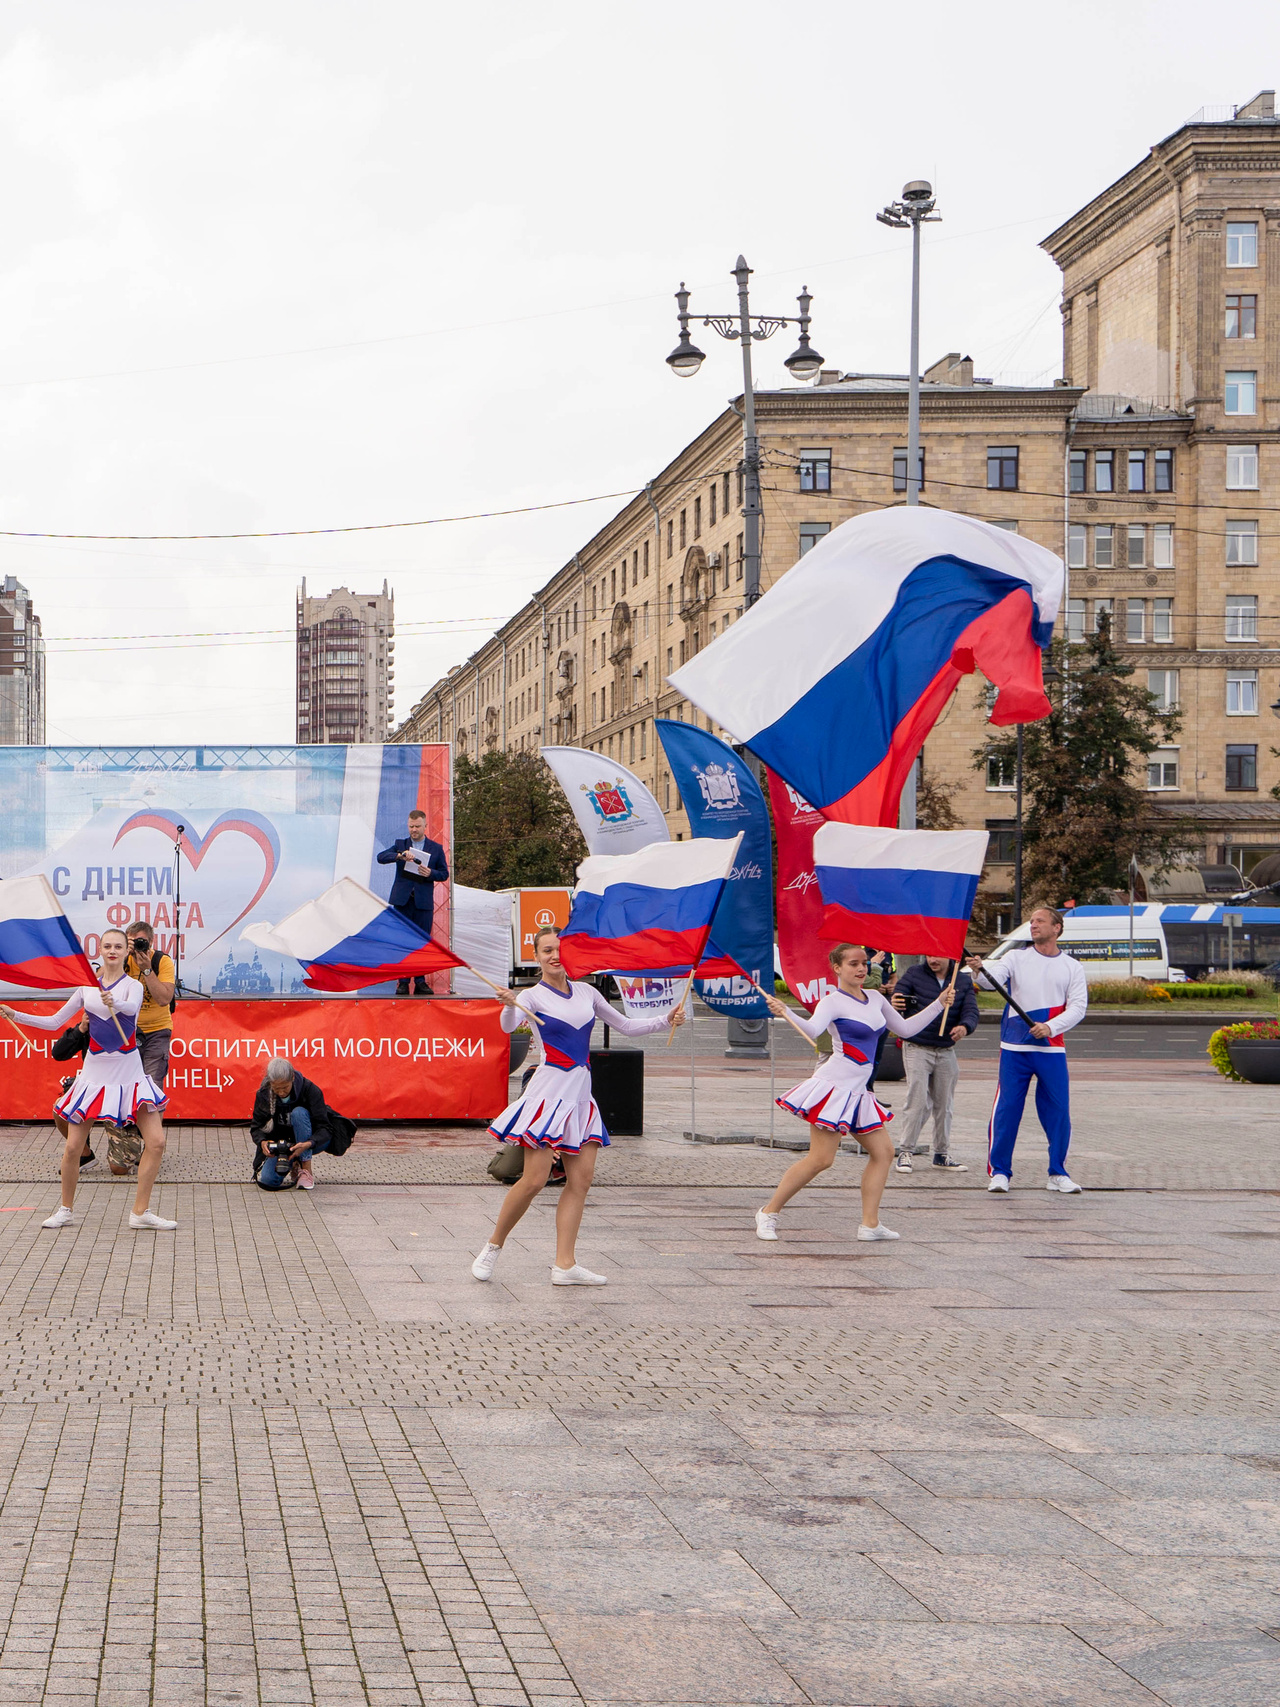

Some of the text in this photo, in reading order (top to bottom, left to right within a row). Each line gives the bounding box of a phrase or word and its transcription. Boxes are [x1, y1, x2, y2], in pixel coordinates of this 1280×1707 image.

[52, 866, 172, 901] С ДНЕМ
[702, 995, 760, 1006] ПЕТЕРБУРГ
[168, 1037, 326, 1058] ОСПИТАНИЯ
[334, 1037, 486, 1062] МОЛОДЕЖИ
